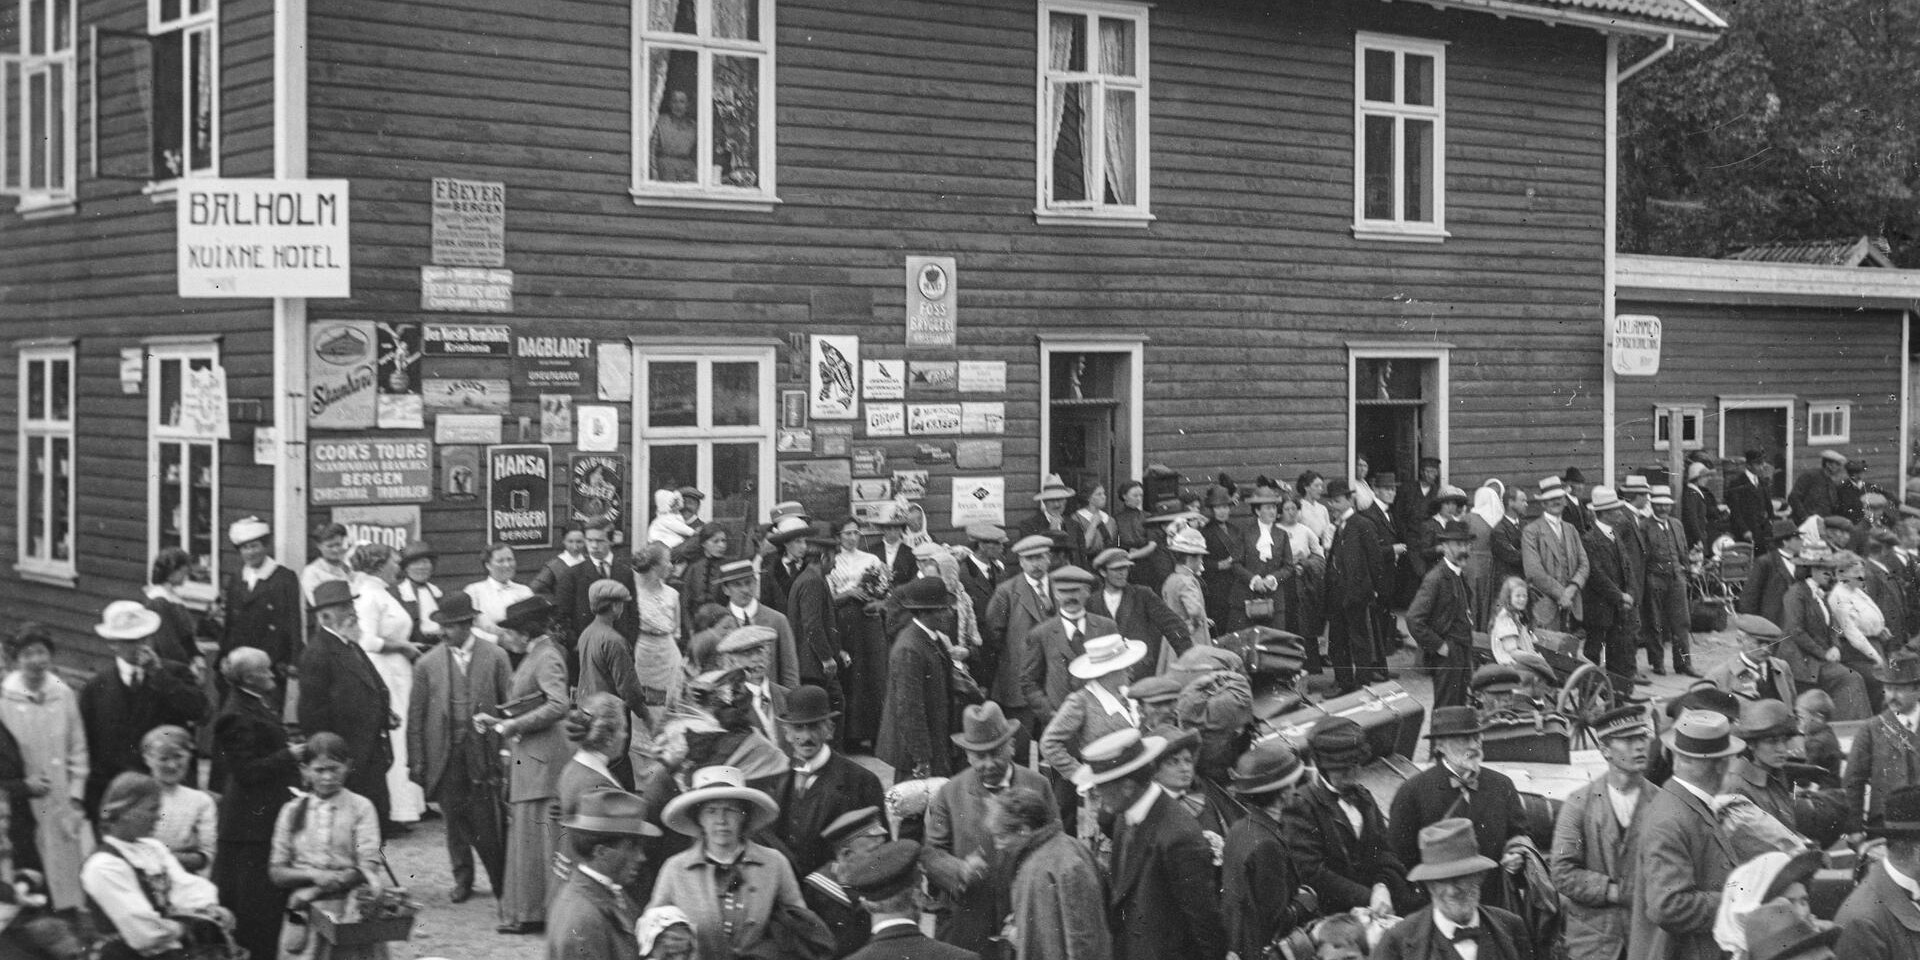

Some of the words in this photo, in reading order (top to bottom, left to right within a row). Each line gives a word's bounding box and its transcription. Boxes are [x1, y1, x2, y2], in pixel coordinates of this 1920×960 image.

[190, 193, 336, 225] BALHOLM
[272, 244, 341, 268] HOTEL
[921, 302, 947, 318] FOSS
[518, 336, 592, 358] DAGBLADET
[374, 442, 428, 460] TOURS
[494, 454, 547, 480] HANSA
[341, 471, 404, 486] BERGEN
[493, 509, 548, 529] BRYGGERI
[342, 524, 407, 550] MOTOR
[499, 529, 543, 540] BERGEN
